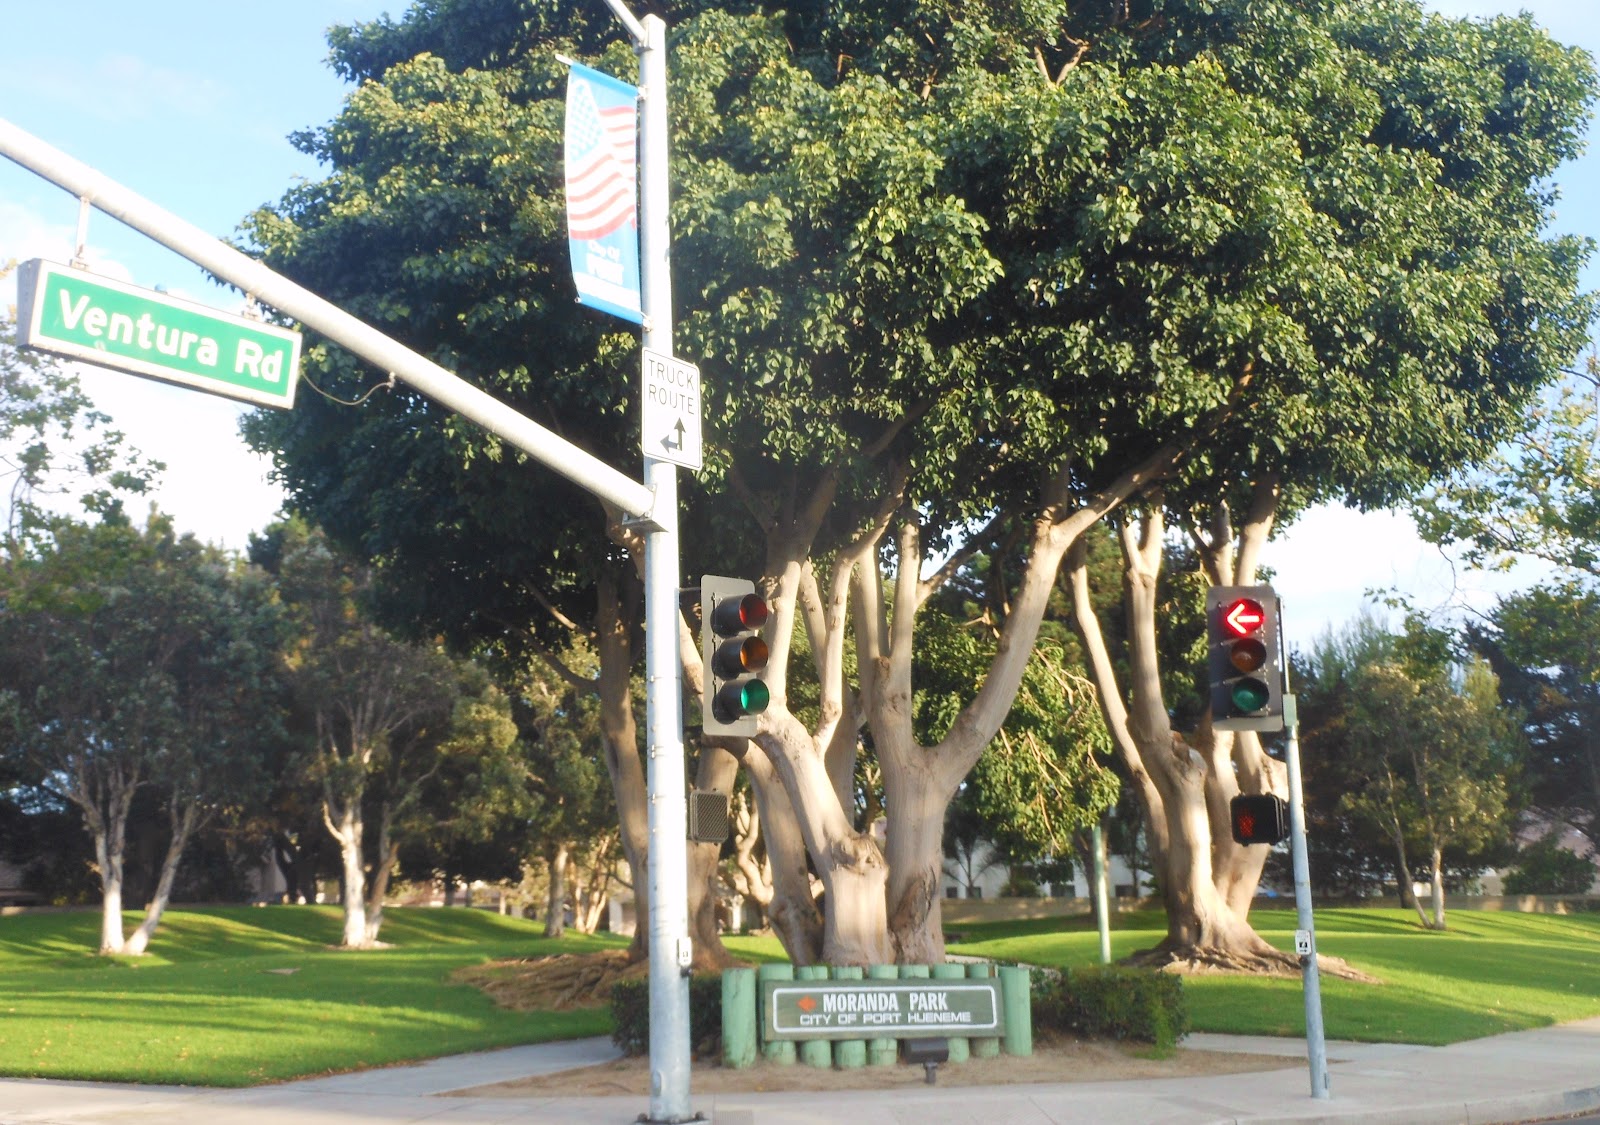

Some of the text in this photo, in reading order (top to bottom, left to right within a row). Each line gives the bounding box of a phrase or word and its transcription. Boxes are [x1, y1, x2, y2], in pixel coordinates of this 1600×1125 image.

[59, 289, 283, 383] Ventura Rd
[649, 359, 695, 391] TRUCK
[649, 384, 695, 415] ROUTE
[823, 992, 949, 1013] MORANDA PARK
[800, 1012, 971, 1025] CITY OF PORT HUENEME
